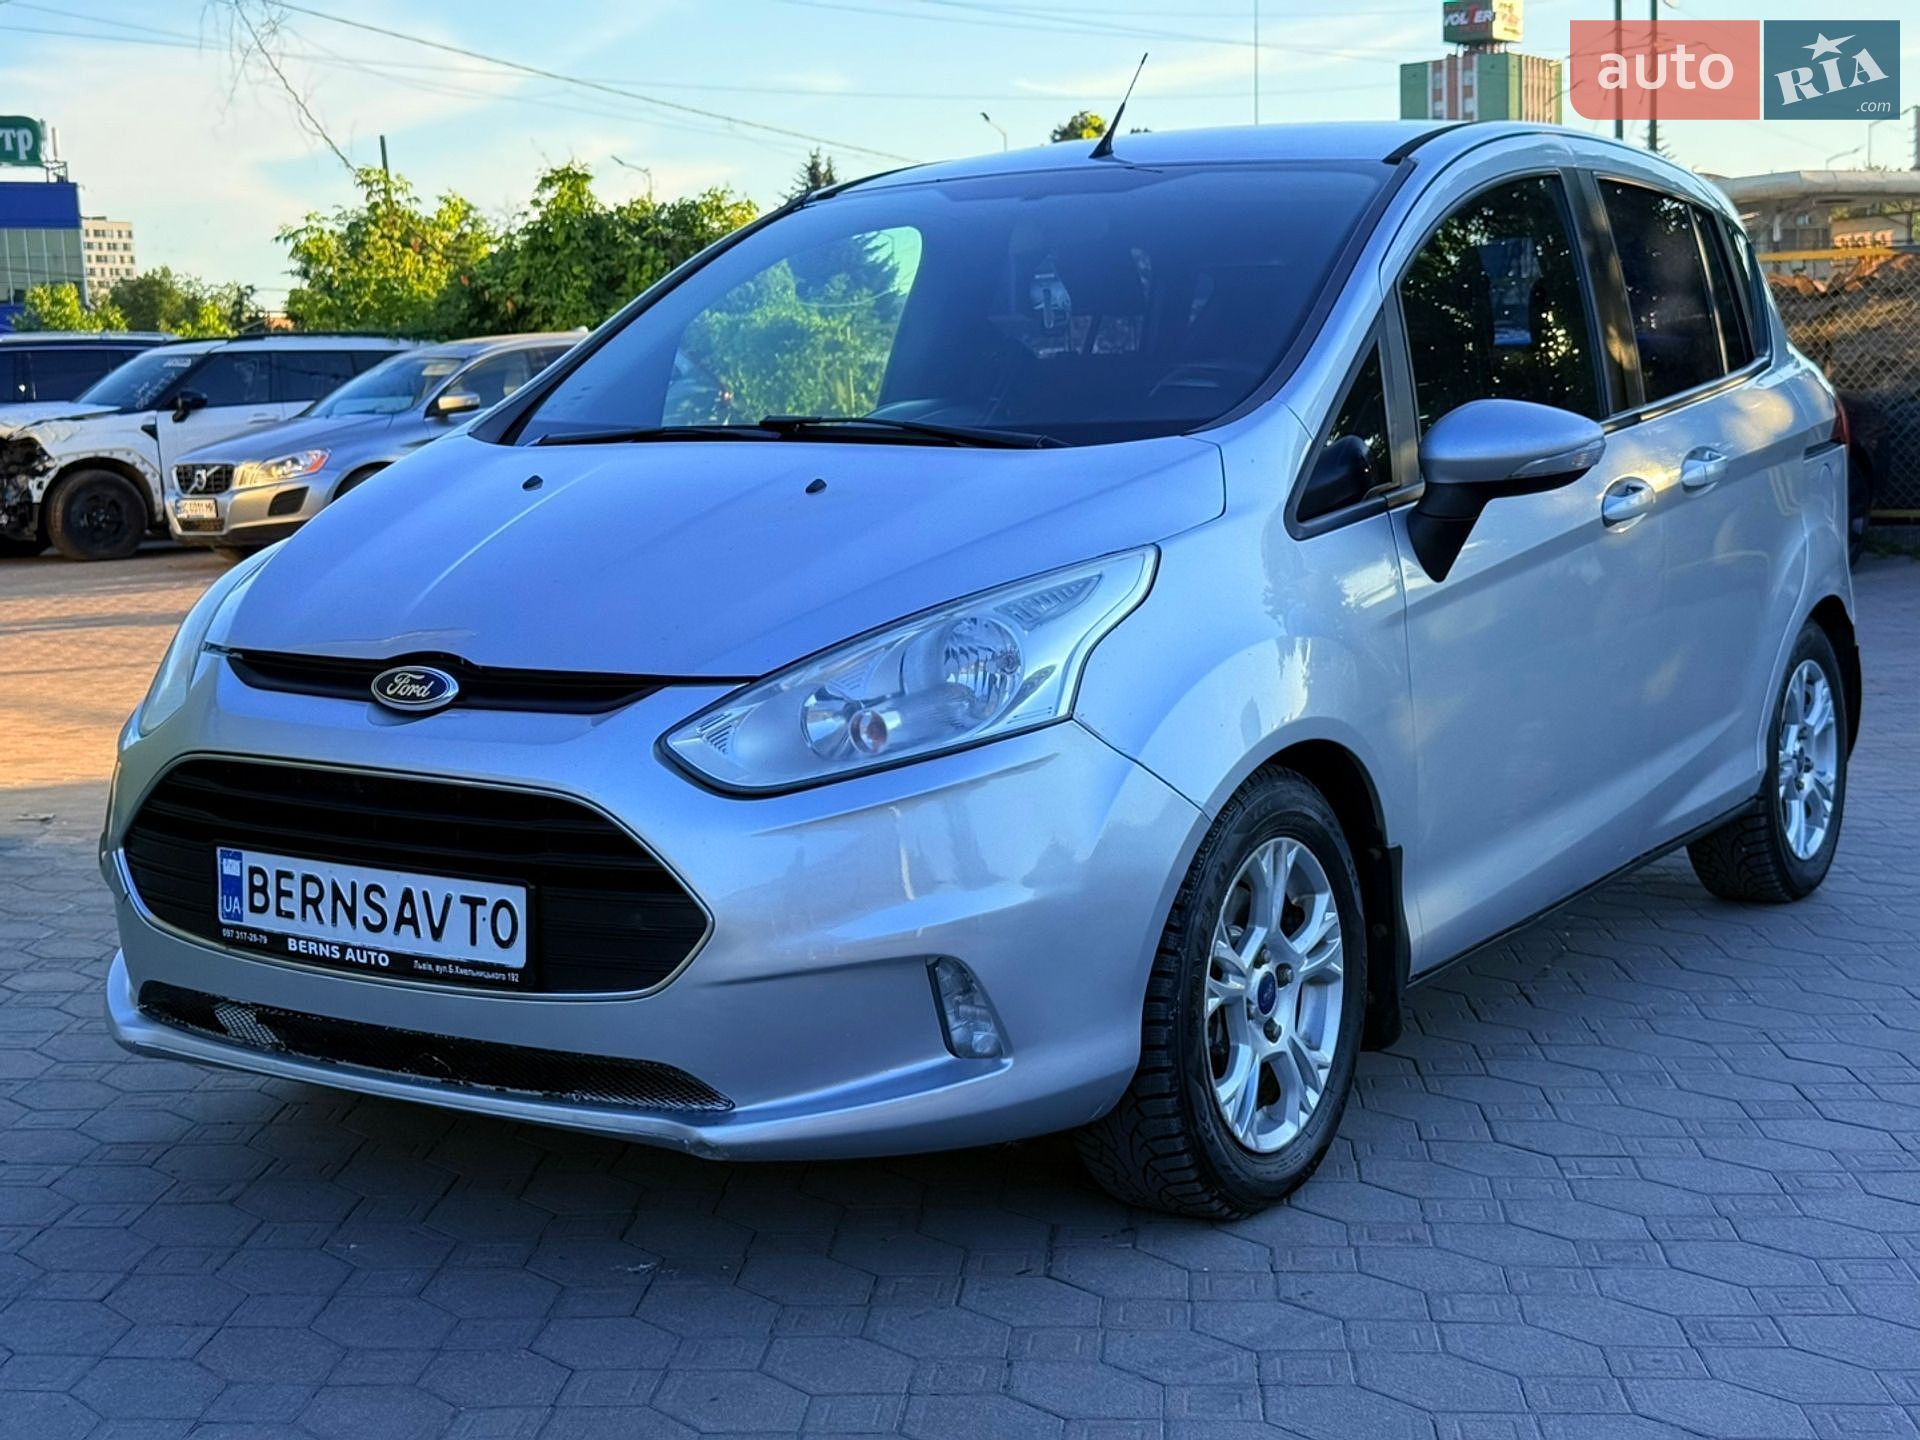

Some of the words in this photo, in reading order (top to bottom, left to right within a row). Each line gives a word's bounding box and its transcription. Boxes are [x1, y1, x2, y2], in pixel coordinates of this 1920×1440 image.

[386, 672, 434, 698] Ford
[223, 895, 242, 915] UA
[247, 864, 519, 950] BERNSAVTO
[287, 937, 341, 960] BERNS
[345, 949, 390, 968] AUTO
